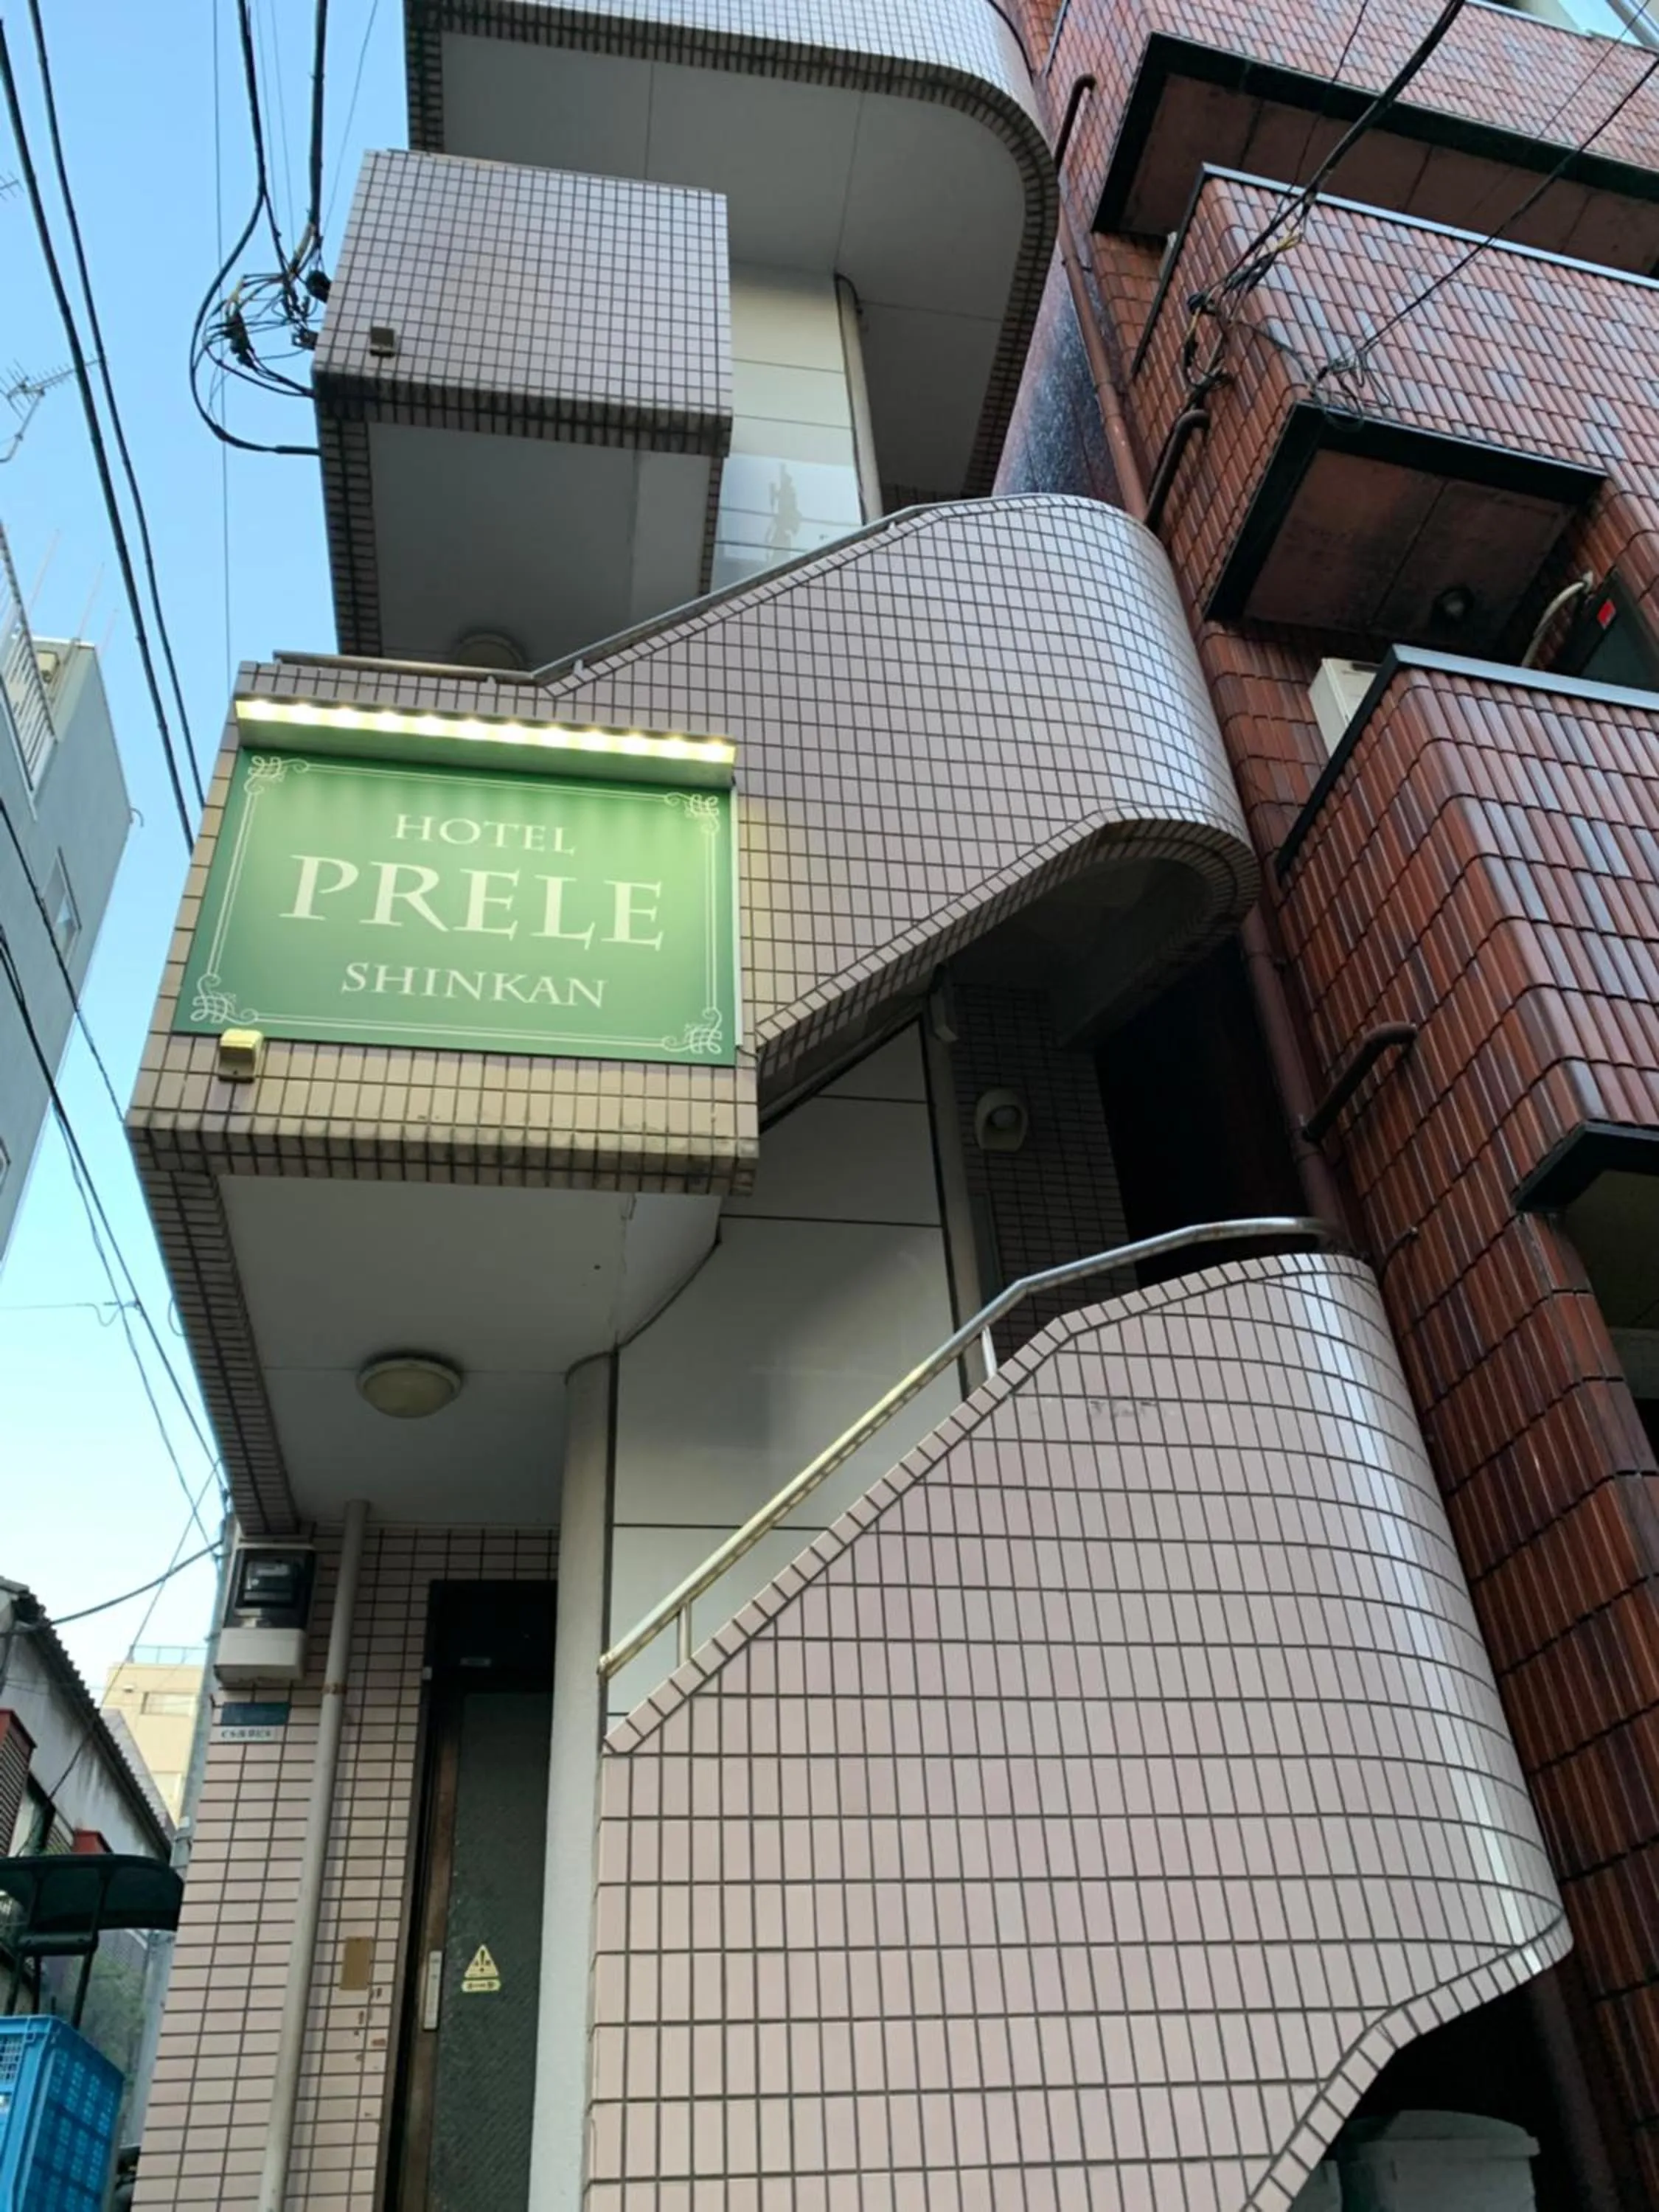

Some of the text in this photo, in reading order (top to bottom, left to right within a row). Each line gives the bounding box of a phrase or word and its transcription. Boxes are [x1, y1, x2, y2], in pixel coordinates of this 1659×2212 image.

[391, 813, 576, 855] HOTEL
[278, 855, 664, 952] PRELE
[341, 961, 607, 1009] SHINKAN
